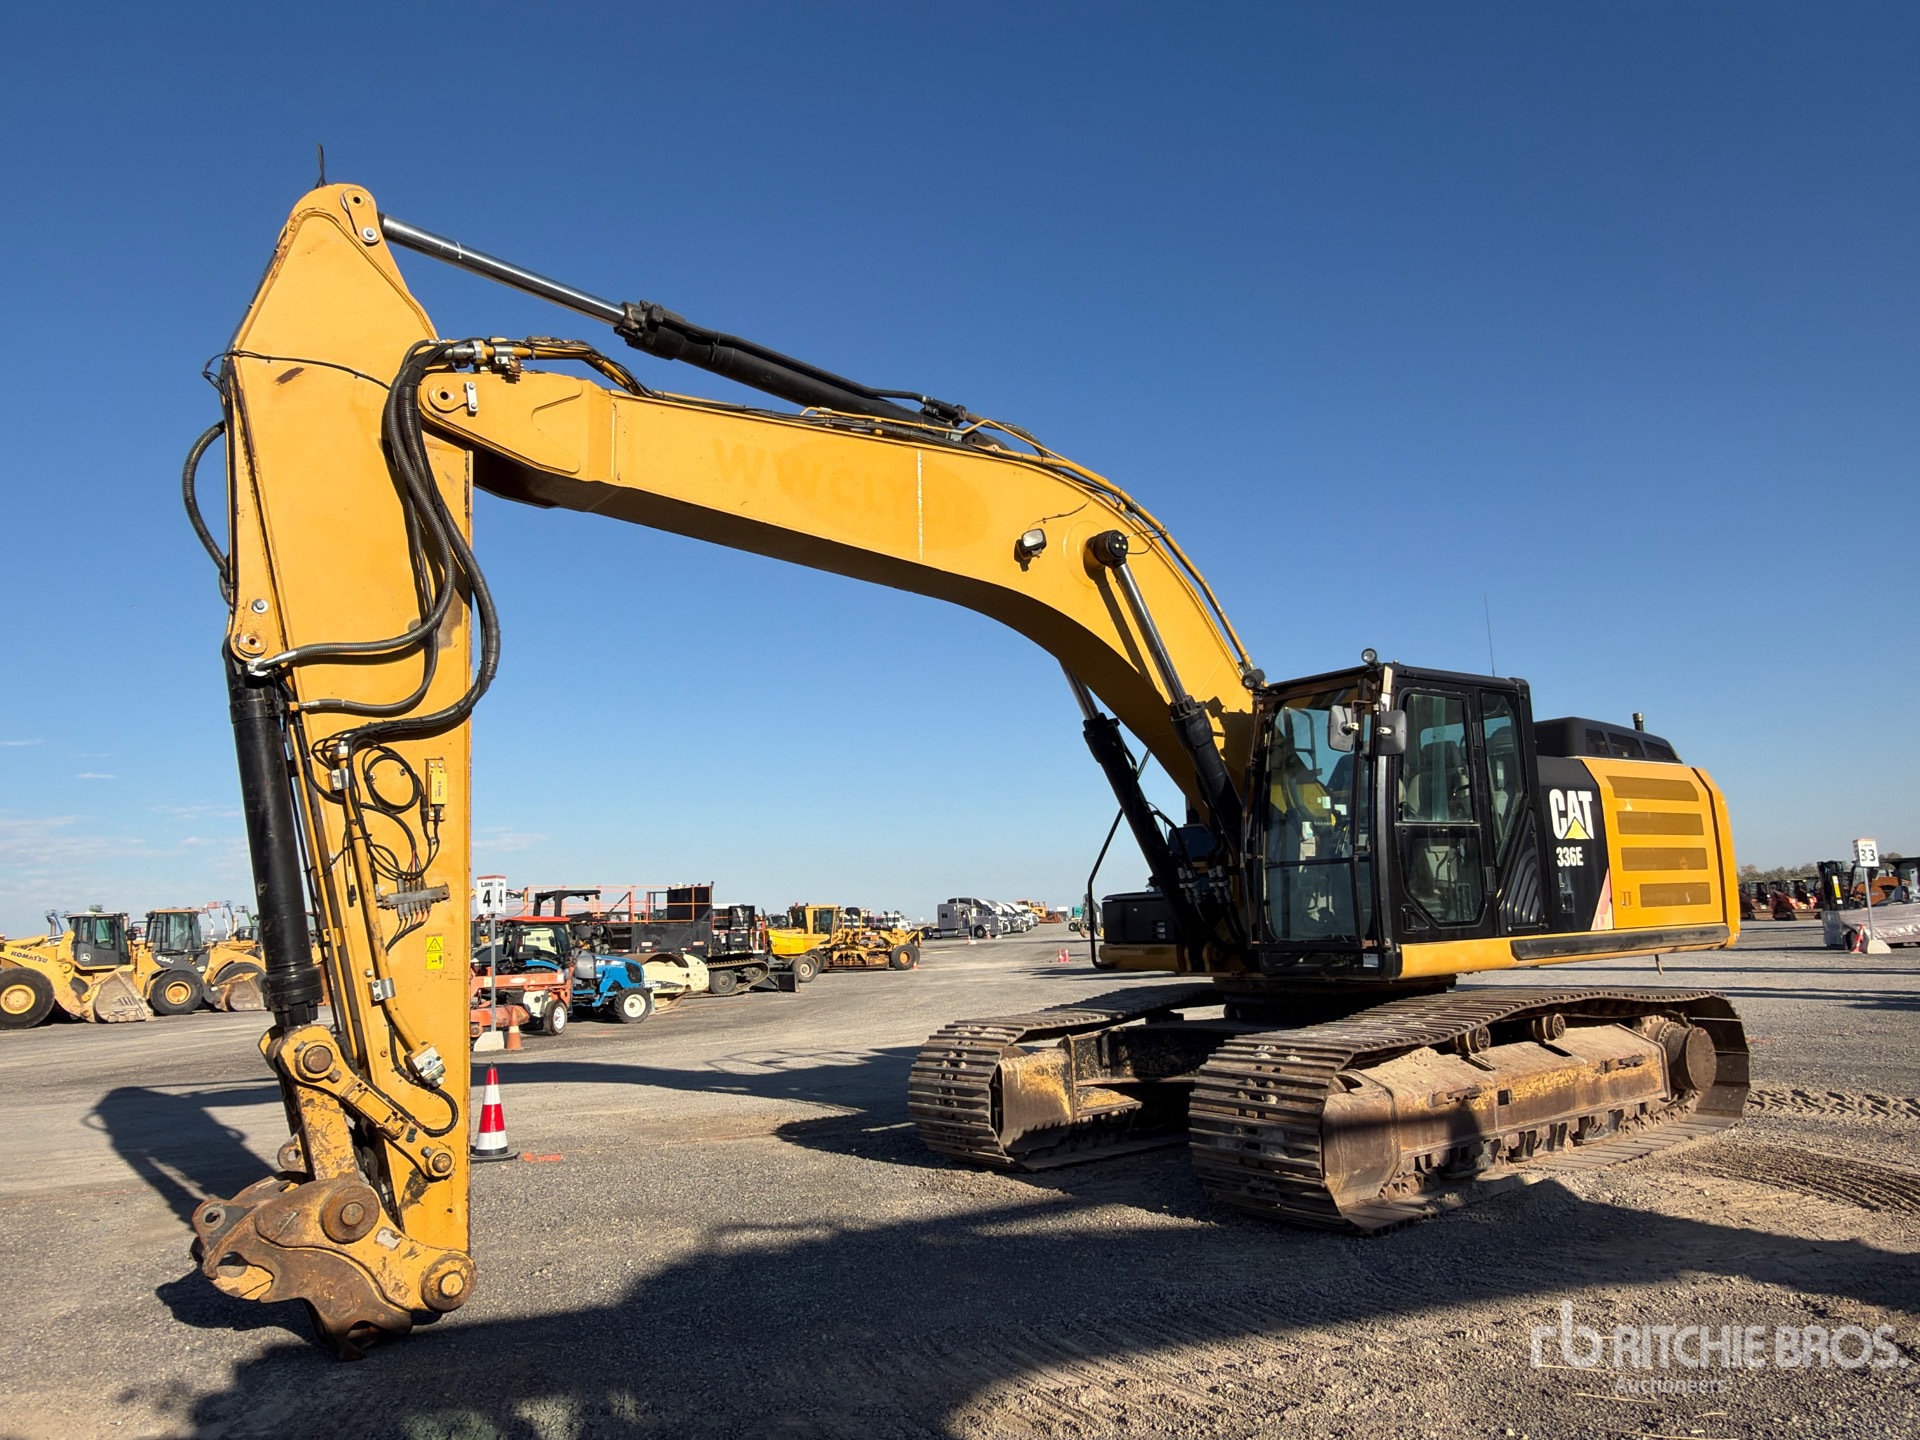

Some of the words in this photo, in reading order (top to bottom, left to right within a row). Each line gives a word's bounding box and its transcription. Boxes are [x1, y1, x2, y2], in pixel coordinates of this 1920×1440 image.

[1549, 788, 1595, 840] CAT
[1556, 846, 1584, 867] 336E
[1861, 849, 1875, 861] 33
[482, 889, 492, 908] 4
[10, 950, 49, 963] KOMATSU
